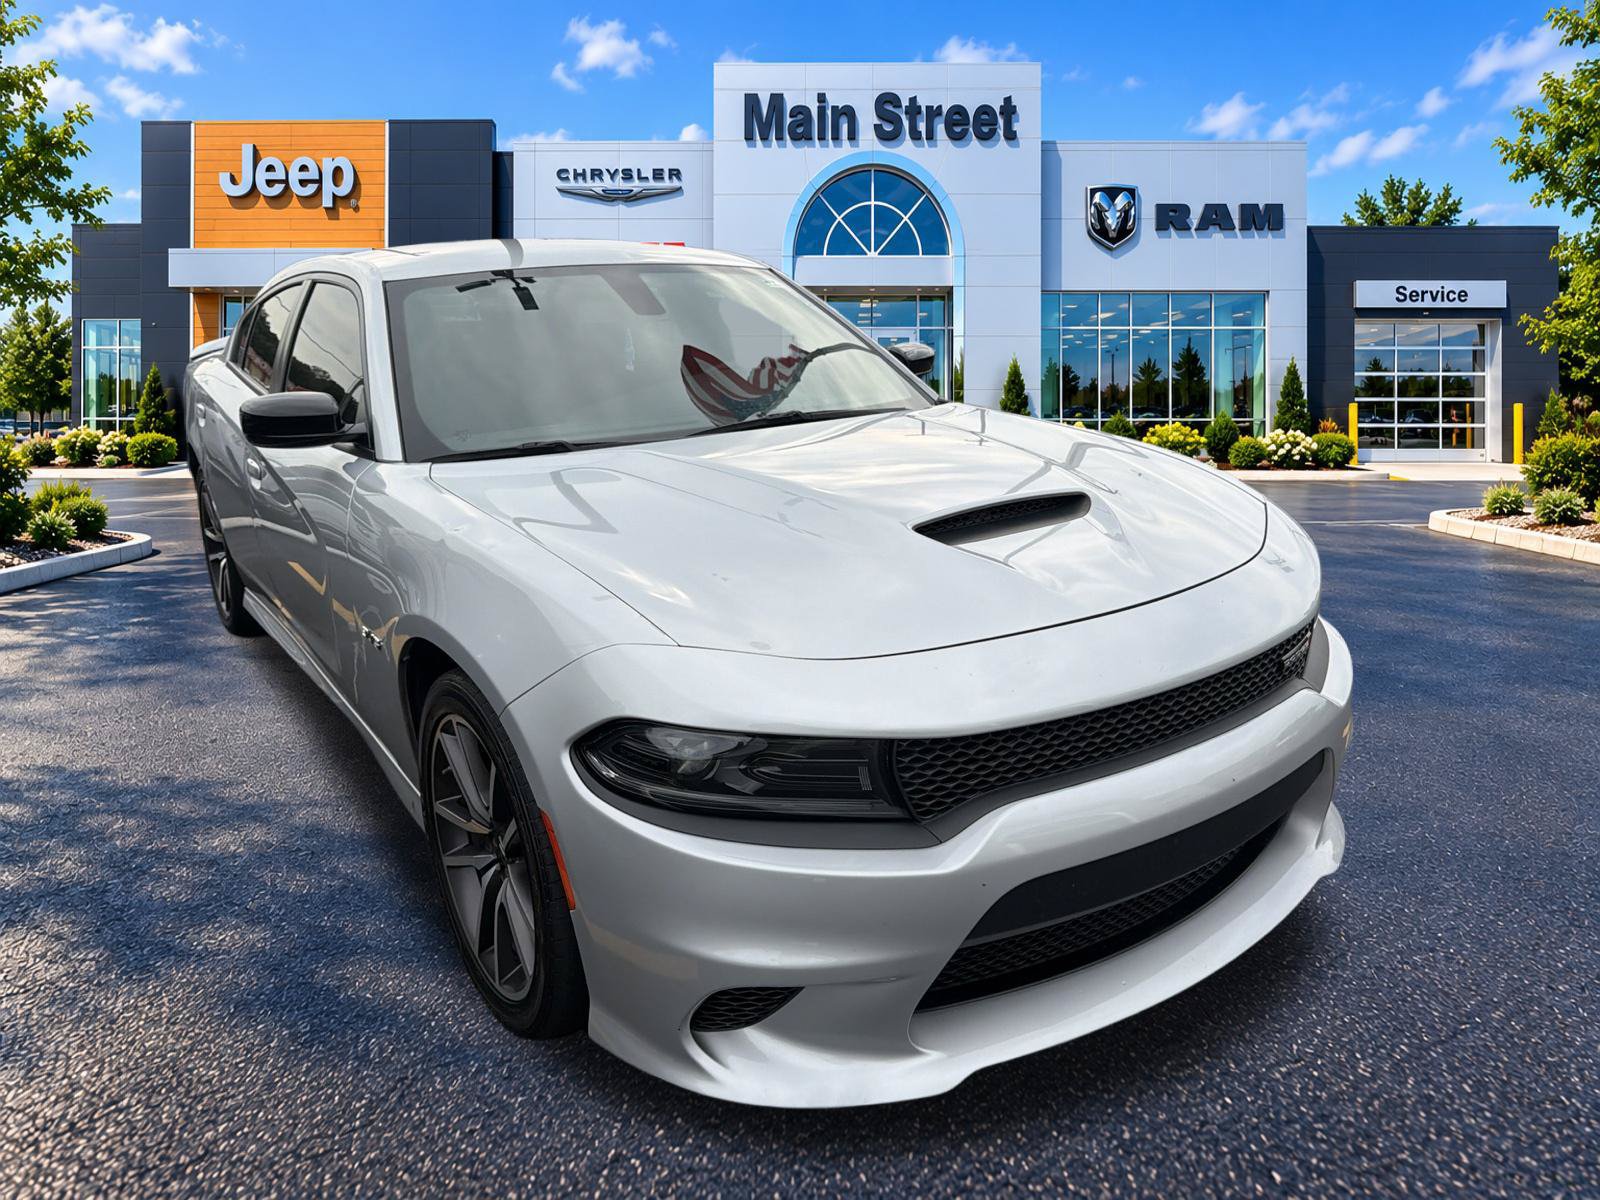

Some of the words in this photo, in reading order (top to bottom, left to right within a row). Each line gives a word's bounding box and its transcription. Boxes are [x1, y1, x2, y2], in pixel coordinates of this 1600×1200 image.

[744, 92, 857, 141] Main
[873, 91, 1018, 141] Street
[218, 143, 355, 209] Jeep
[556, 168, 683, 182] CHRYSLER
[1155, 203, 1284, 232] RAM
[1395, 285, 1469, 303] Service
